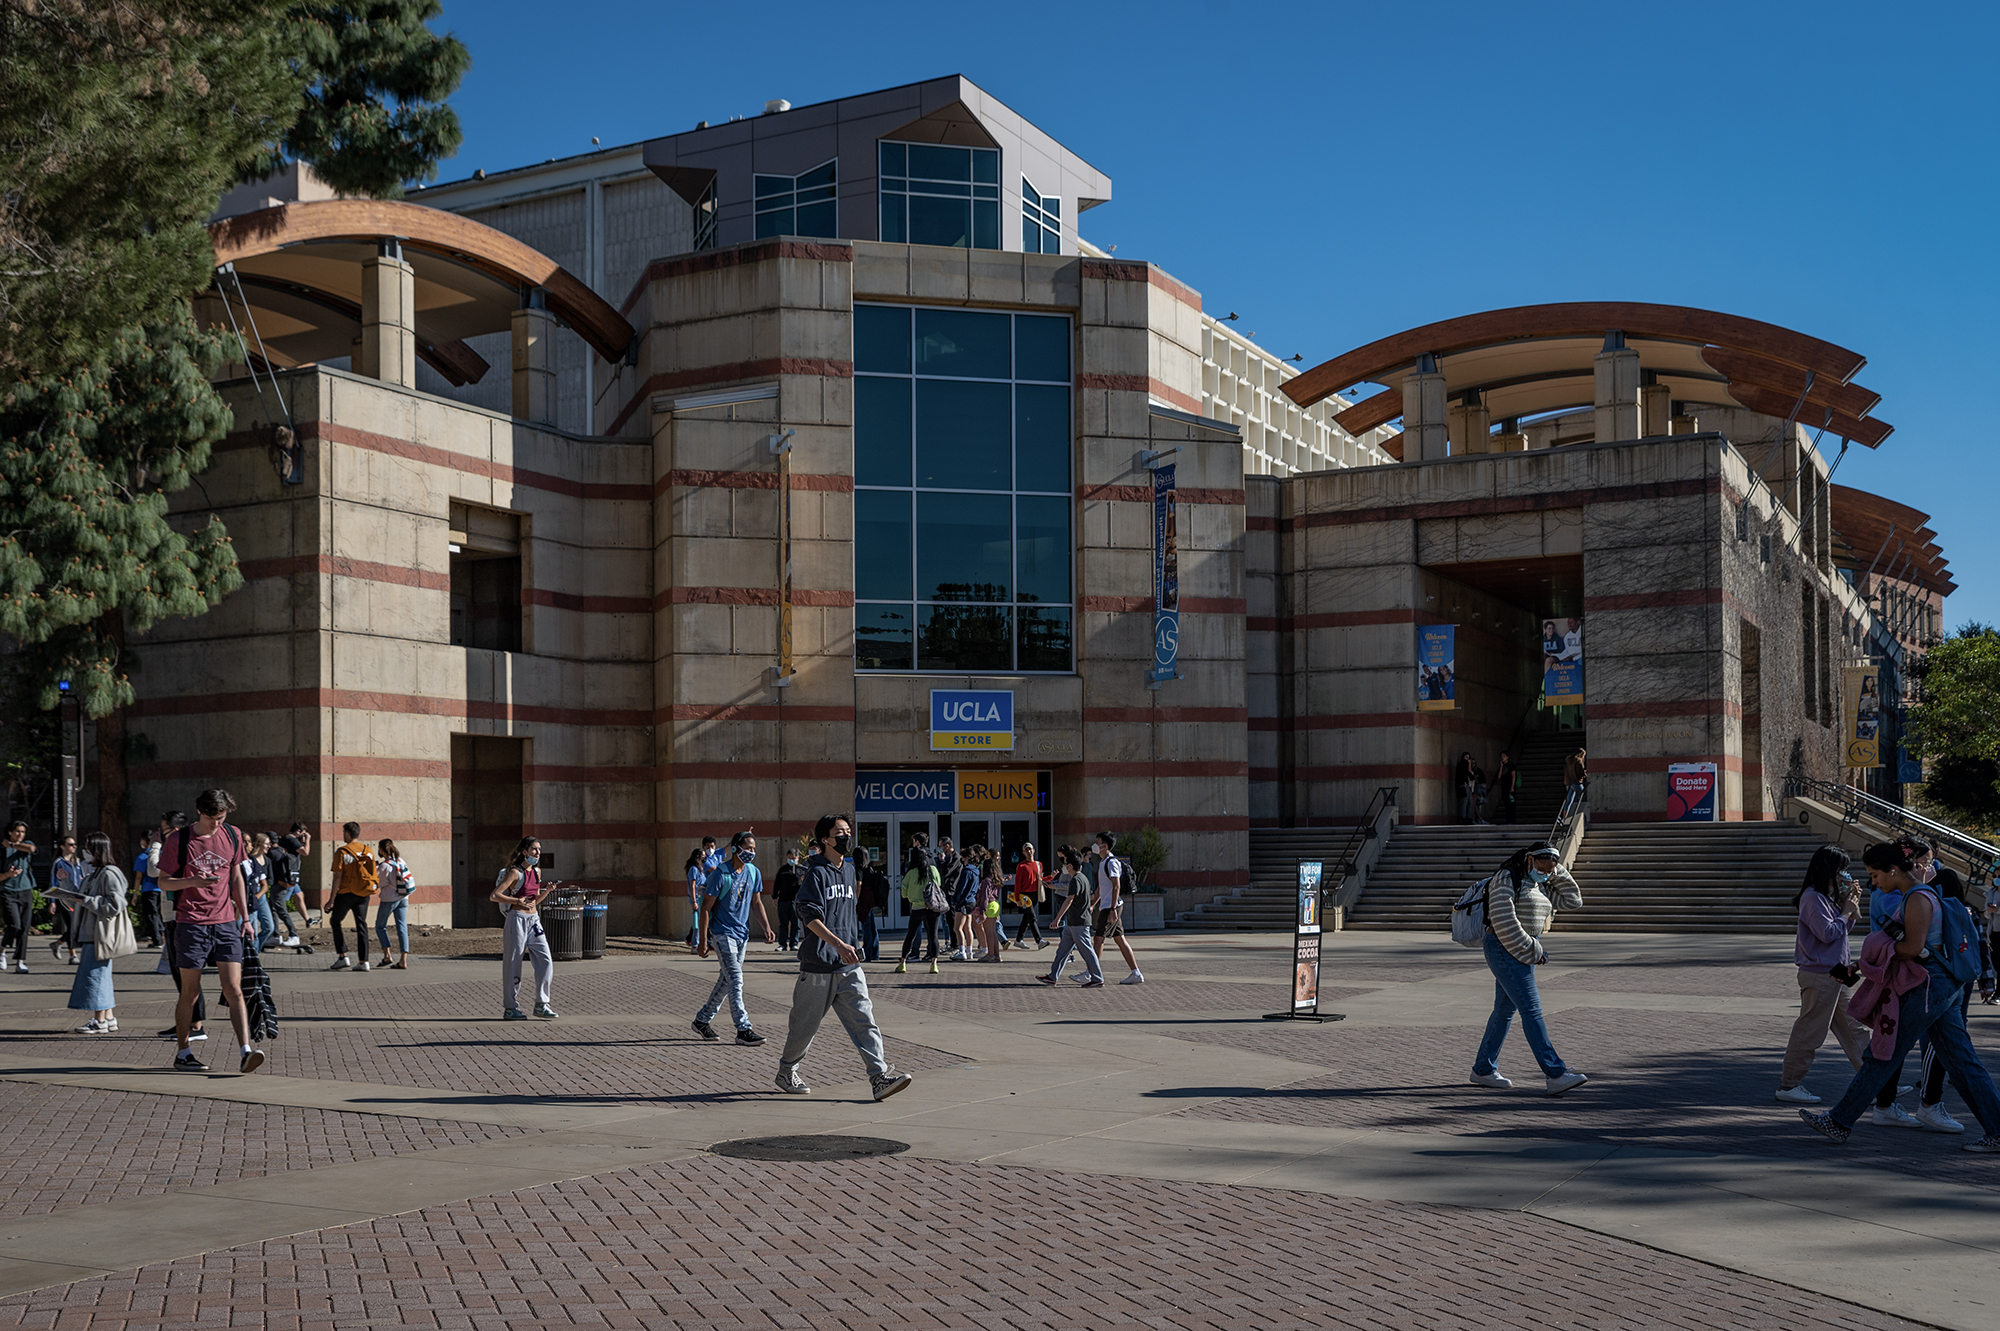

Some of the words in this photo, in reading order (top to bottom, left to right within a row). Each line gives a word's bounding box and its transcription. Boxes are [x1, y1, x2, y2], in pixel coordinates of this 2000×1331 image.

[943, 702, 1001, 721] UCLA
[1665, 730, 1692, 738] UNION
[954, 735, 992, 744] STORE
[855, 783, 950, 799] WELCOME
[963, 783, 1034, 799] BRUINS
[1300, 865, 1311, 874] TWO
[1312, 865, 1322, 874] FOR
[826, 884, 854, 900] UCLA
[1298, 948, 1318, 958] COCOA
